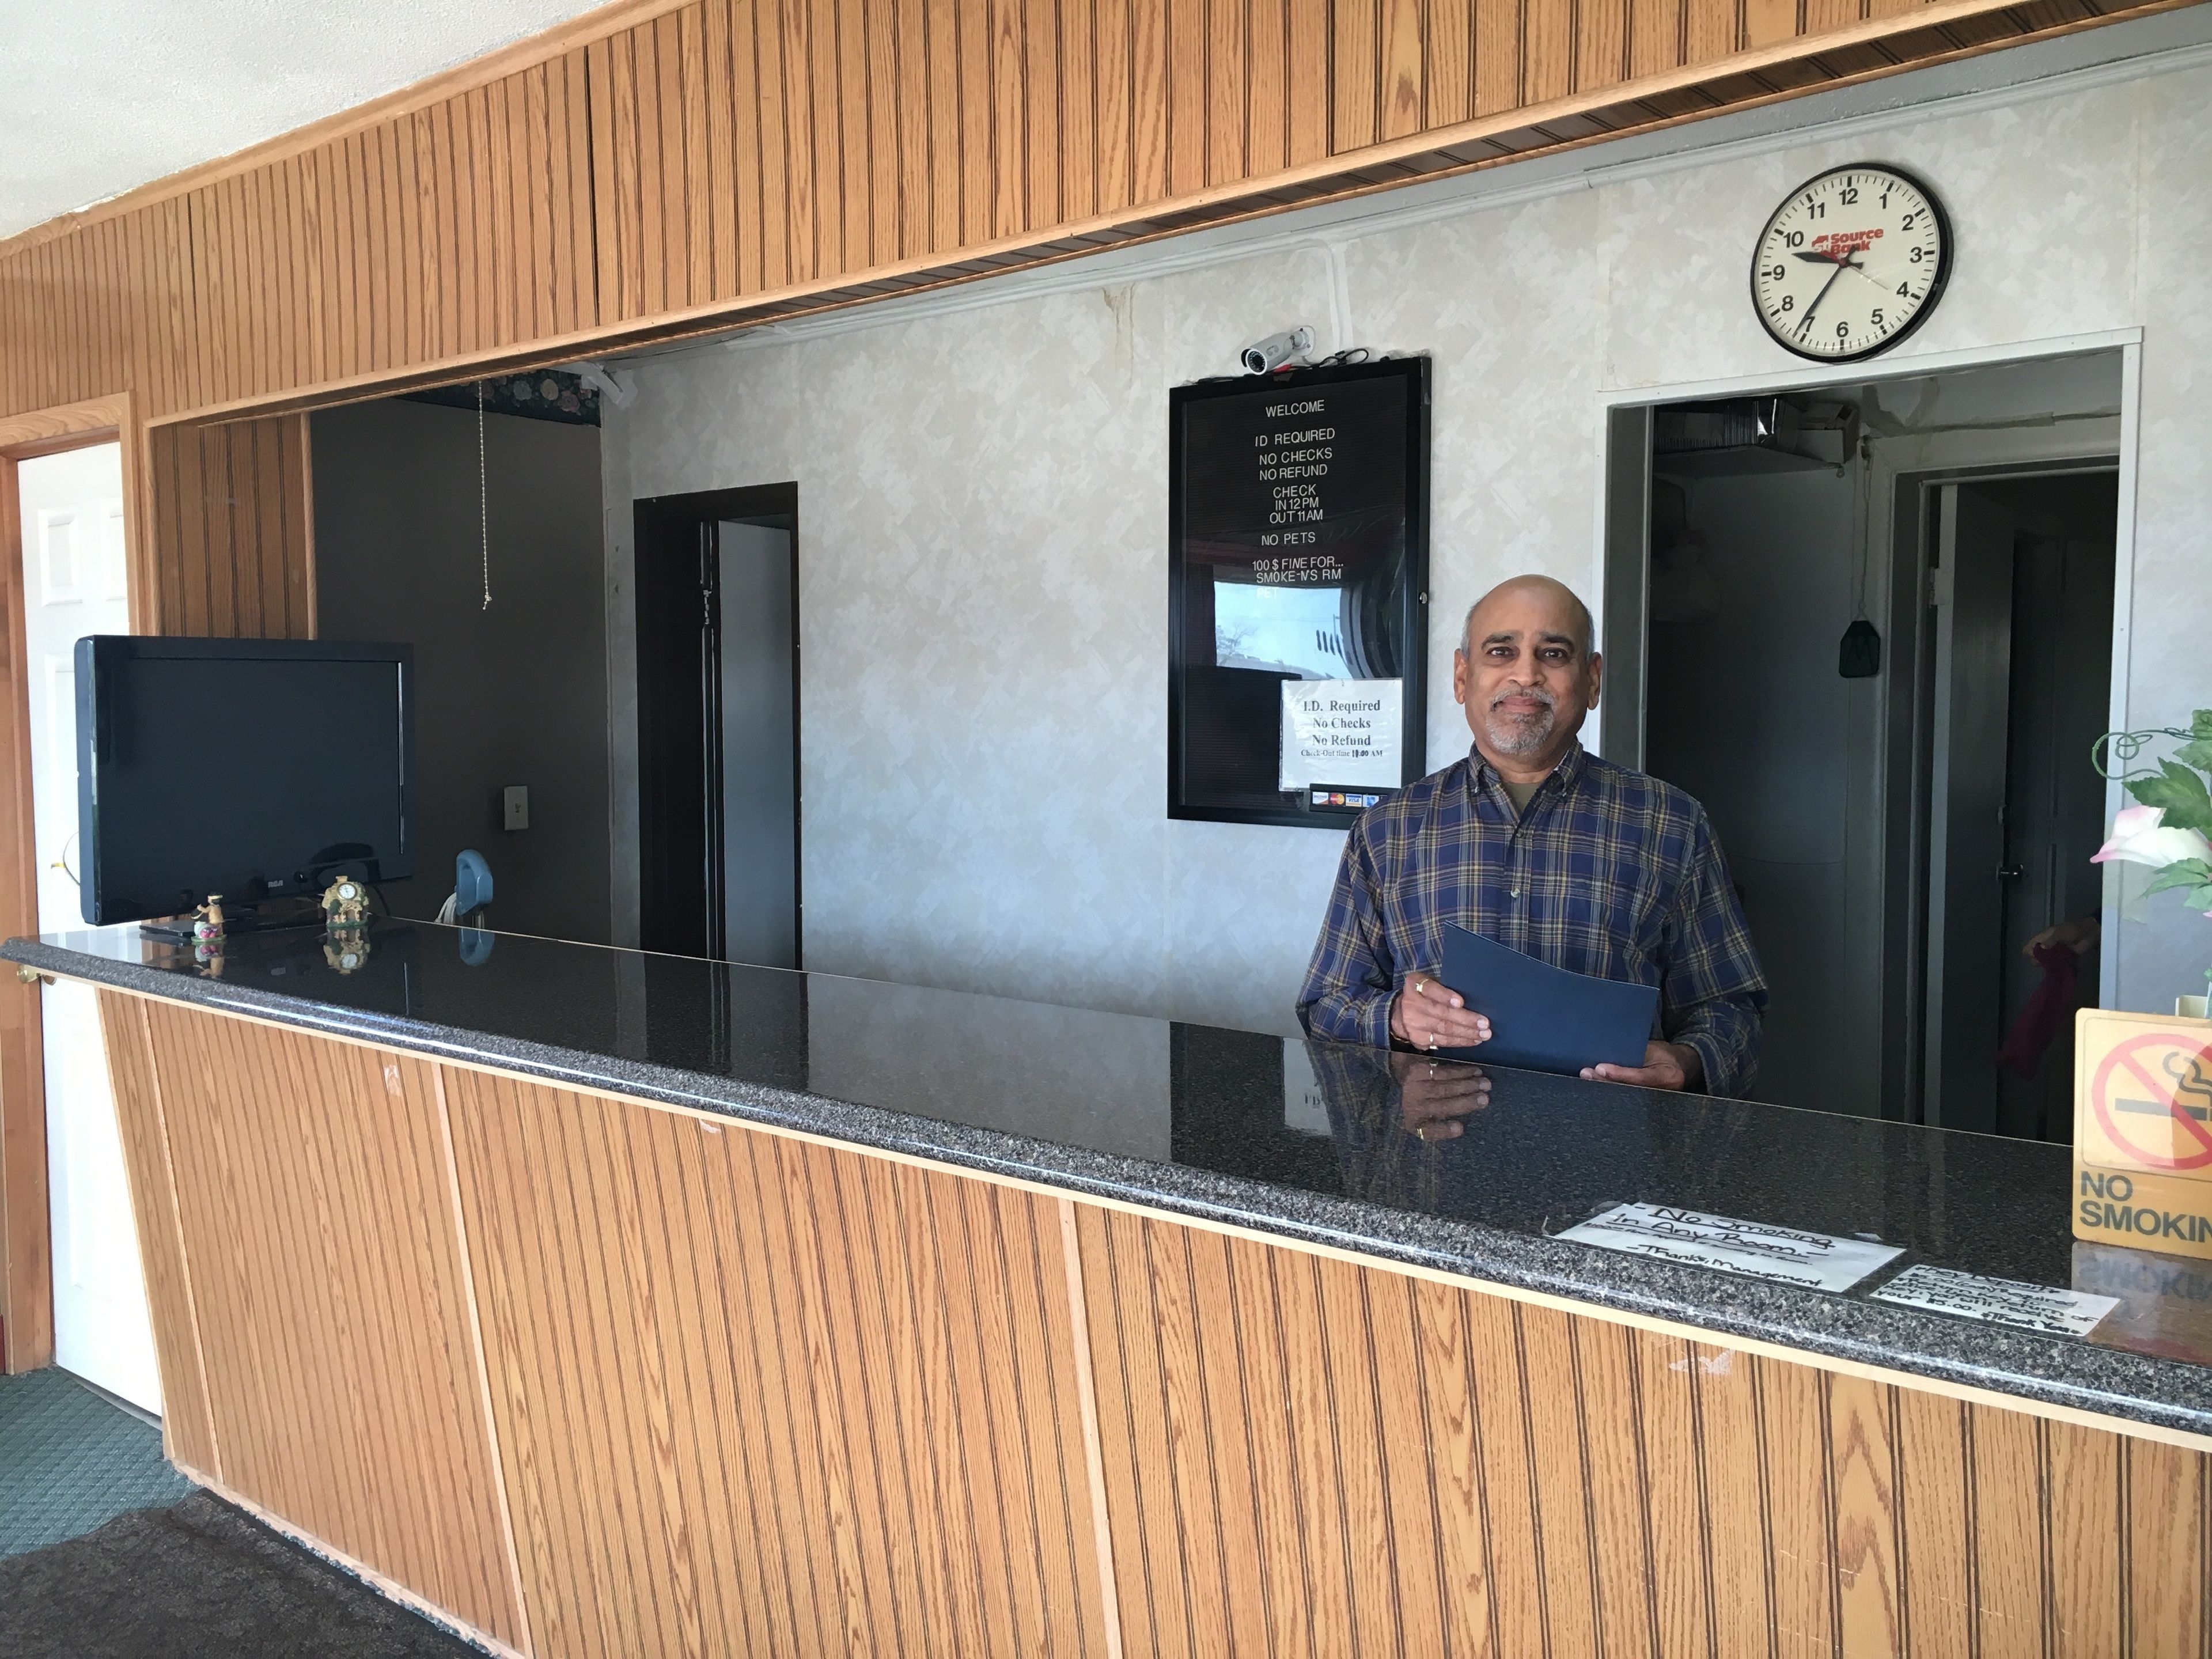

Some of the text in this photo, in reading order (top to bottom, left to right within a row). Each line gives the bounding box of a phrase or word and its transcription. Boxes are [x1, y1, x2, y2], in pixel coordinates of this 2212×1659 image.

[1839, 188, 1858, 205] 12
[1879, 194, 1887, 209] 1
[1807, 202, 1825, 219] 11
[1902, 214, 1914, 231] 2
[1783, 230, 1804, 248] 10
[1831, 228, 1884, 244] Source
[1910, 247, 1922, 263] 3
[1772, 265, 1785, 281] 9
[1896, 281, 1909, 297] 4
[1781, 295, 1794, 311] 8
[1805, 316, 1815, 332] 7
[1870, 308, 1883, 324] 5
[1836, 321, 1849, 337] 6
[1266, 400, 1325, 417] WELCOME
[1255, 427, 1335, 447] ID REQUIRED
[1259, 447, 1333, 465] NO CHECKS
[1259, 464, 1328, 481] NO REFUND
[1273, 484, 1317, 499] CHECK
[1275, 499, 1286, 511] IN
[1270, 511, 1296, 524] OUT
[1261, 532, 1316, 546] NO PETS
[1282, 557, 1308, 570] FINE
[1322, 568, 1342, 580] RM
[1304, 699, 1381, 714] I.D. Required
[1313, 717, 1371, 729] No Checks
[1312, 734, 1371, 746] No Refund
[2080, 1171, 2133, 1202] NO
[1651, 1222, 1709, 1241] Any
[1653, 1207, 1833, 1249] No Smoking
